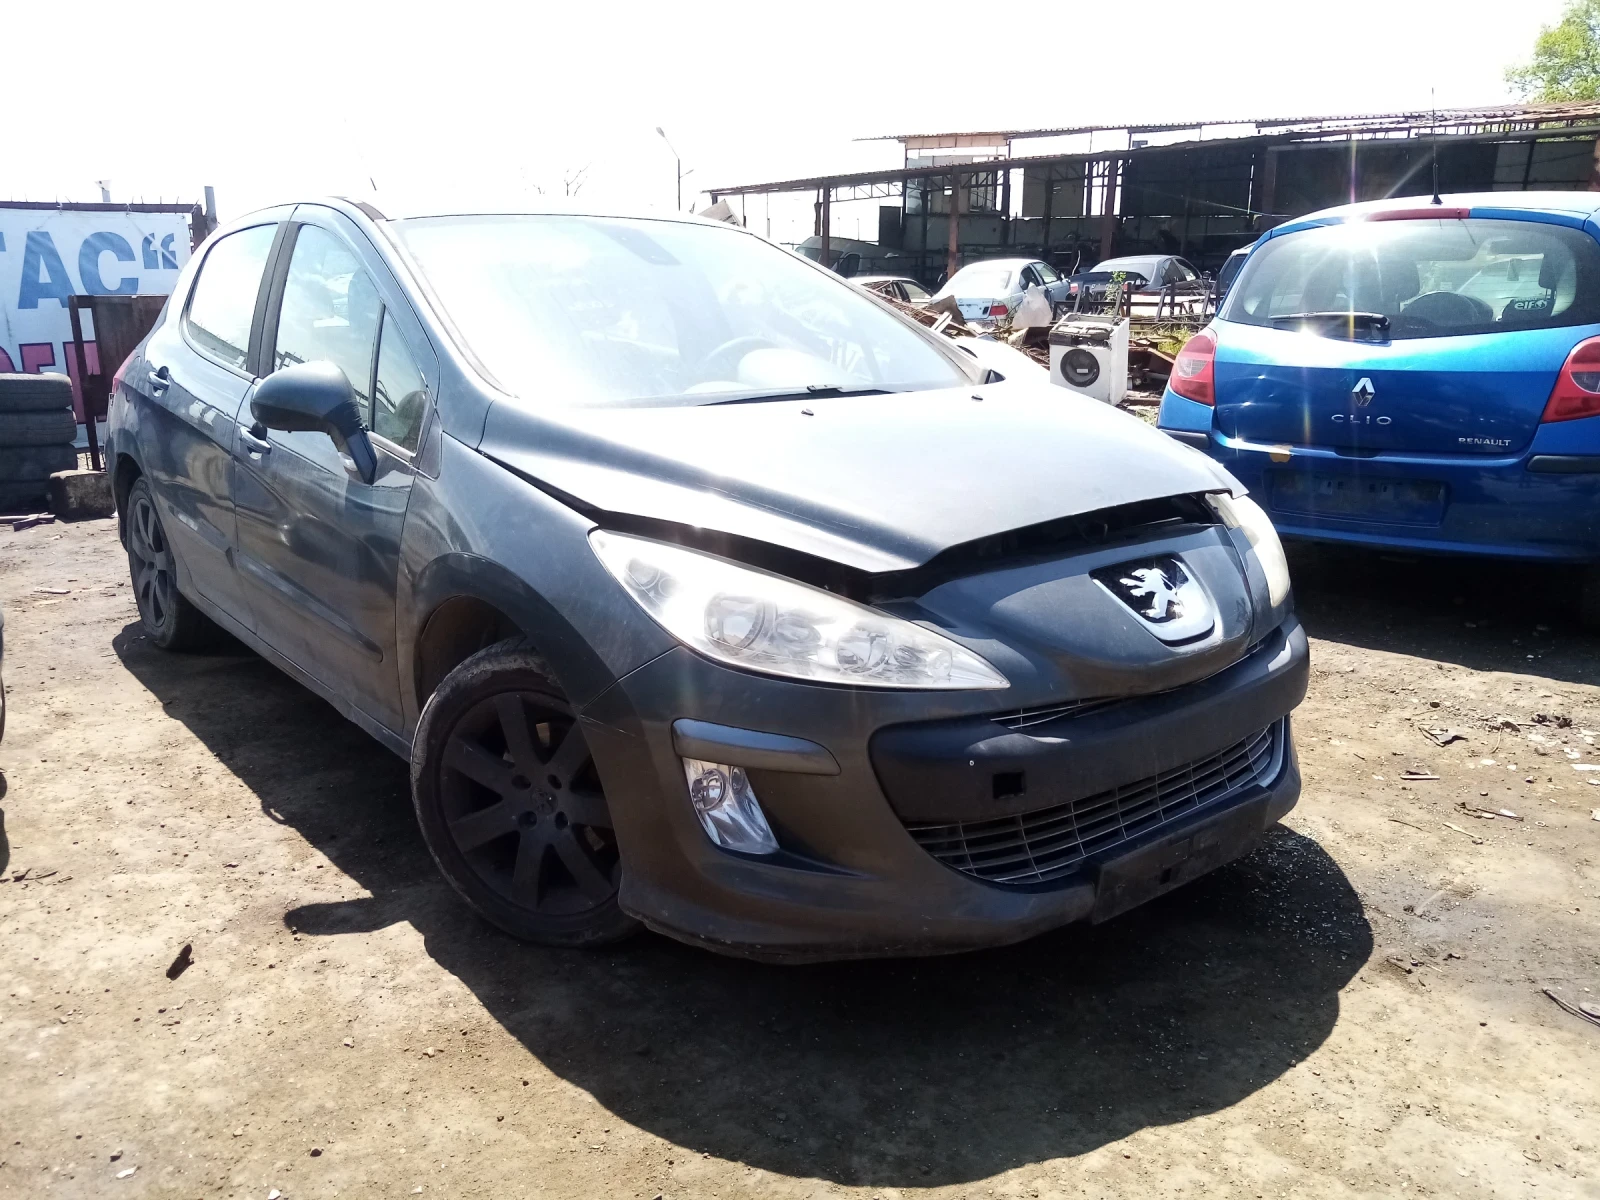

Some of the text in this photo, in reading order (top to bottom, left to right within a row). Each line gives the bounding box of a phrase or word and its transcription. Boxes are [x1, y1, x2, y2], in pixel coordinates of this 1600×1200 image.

[1514, 301, 1535, 310] elf
[1331, 414, 1392, 425] CLIO
[1458, 437, 1511, 446] RENAULT
